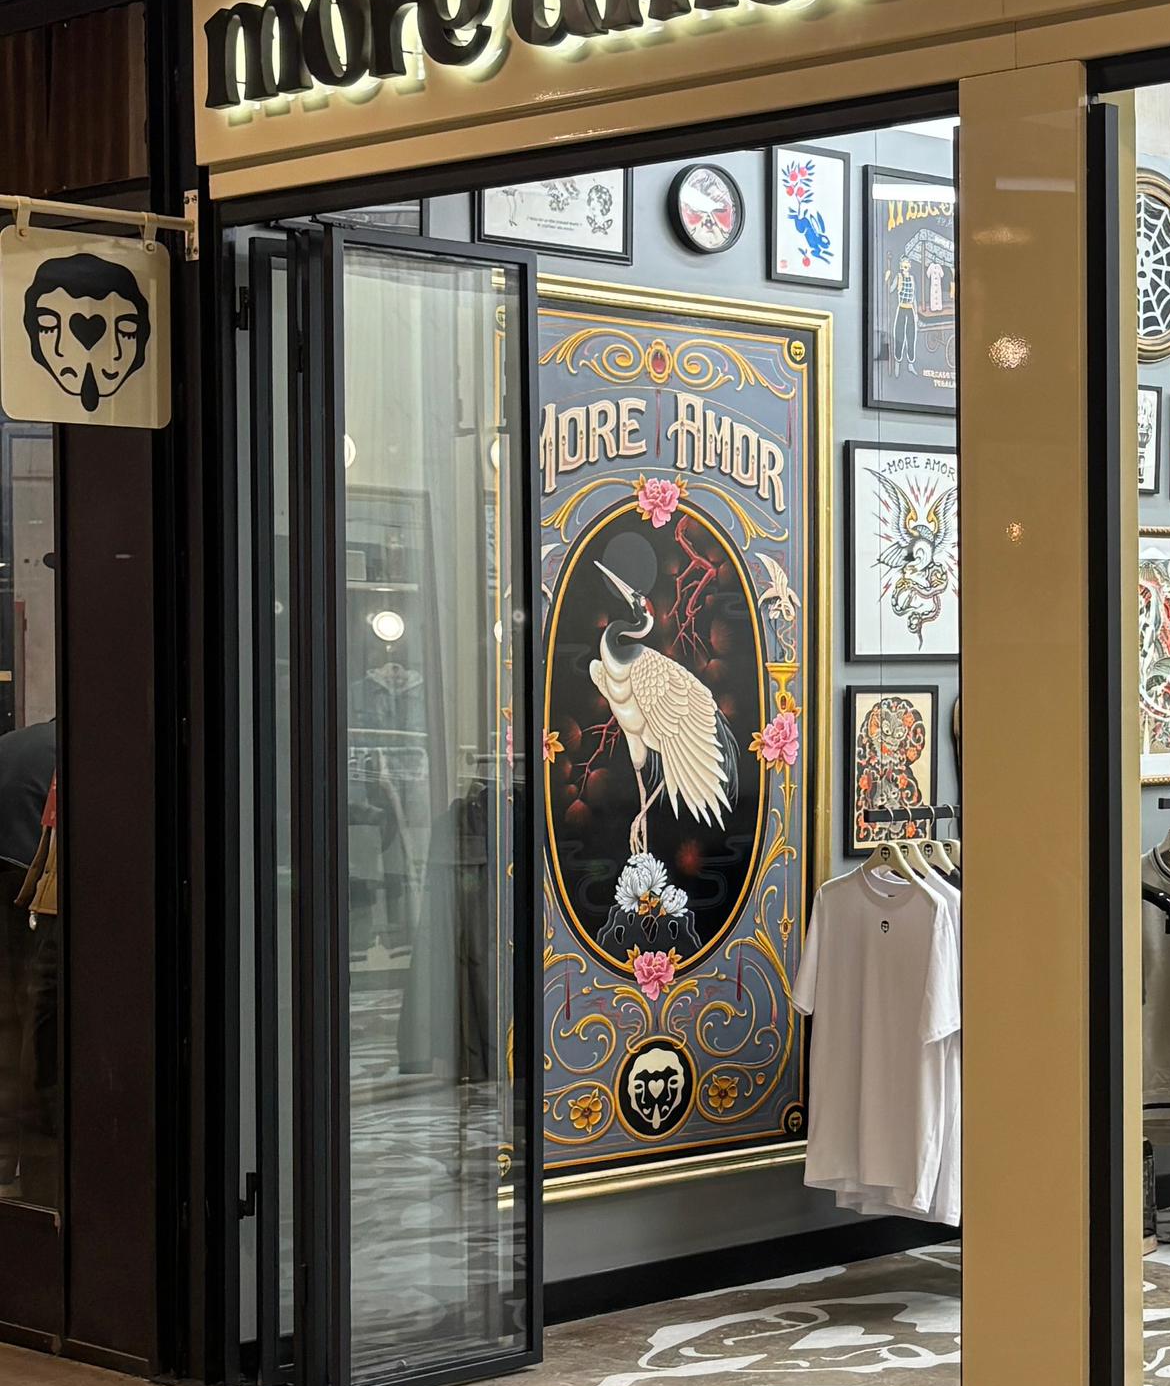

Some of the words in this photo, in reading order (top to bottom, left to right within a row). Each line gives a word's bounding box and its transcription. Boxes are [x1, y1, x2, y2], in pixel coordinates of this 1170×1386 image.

[539, 397, 647, 493] MORE
[667, 392, 786, 512] AMOR
[924, 458, 956, 481] AMOR
